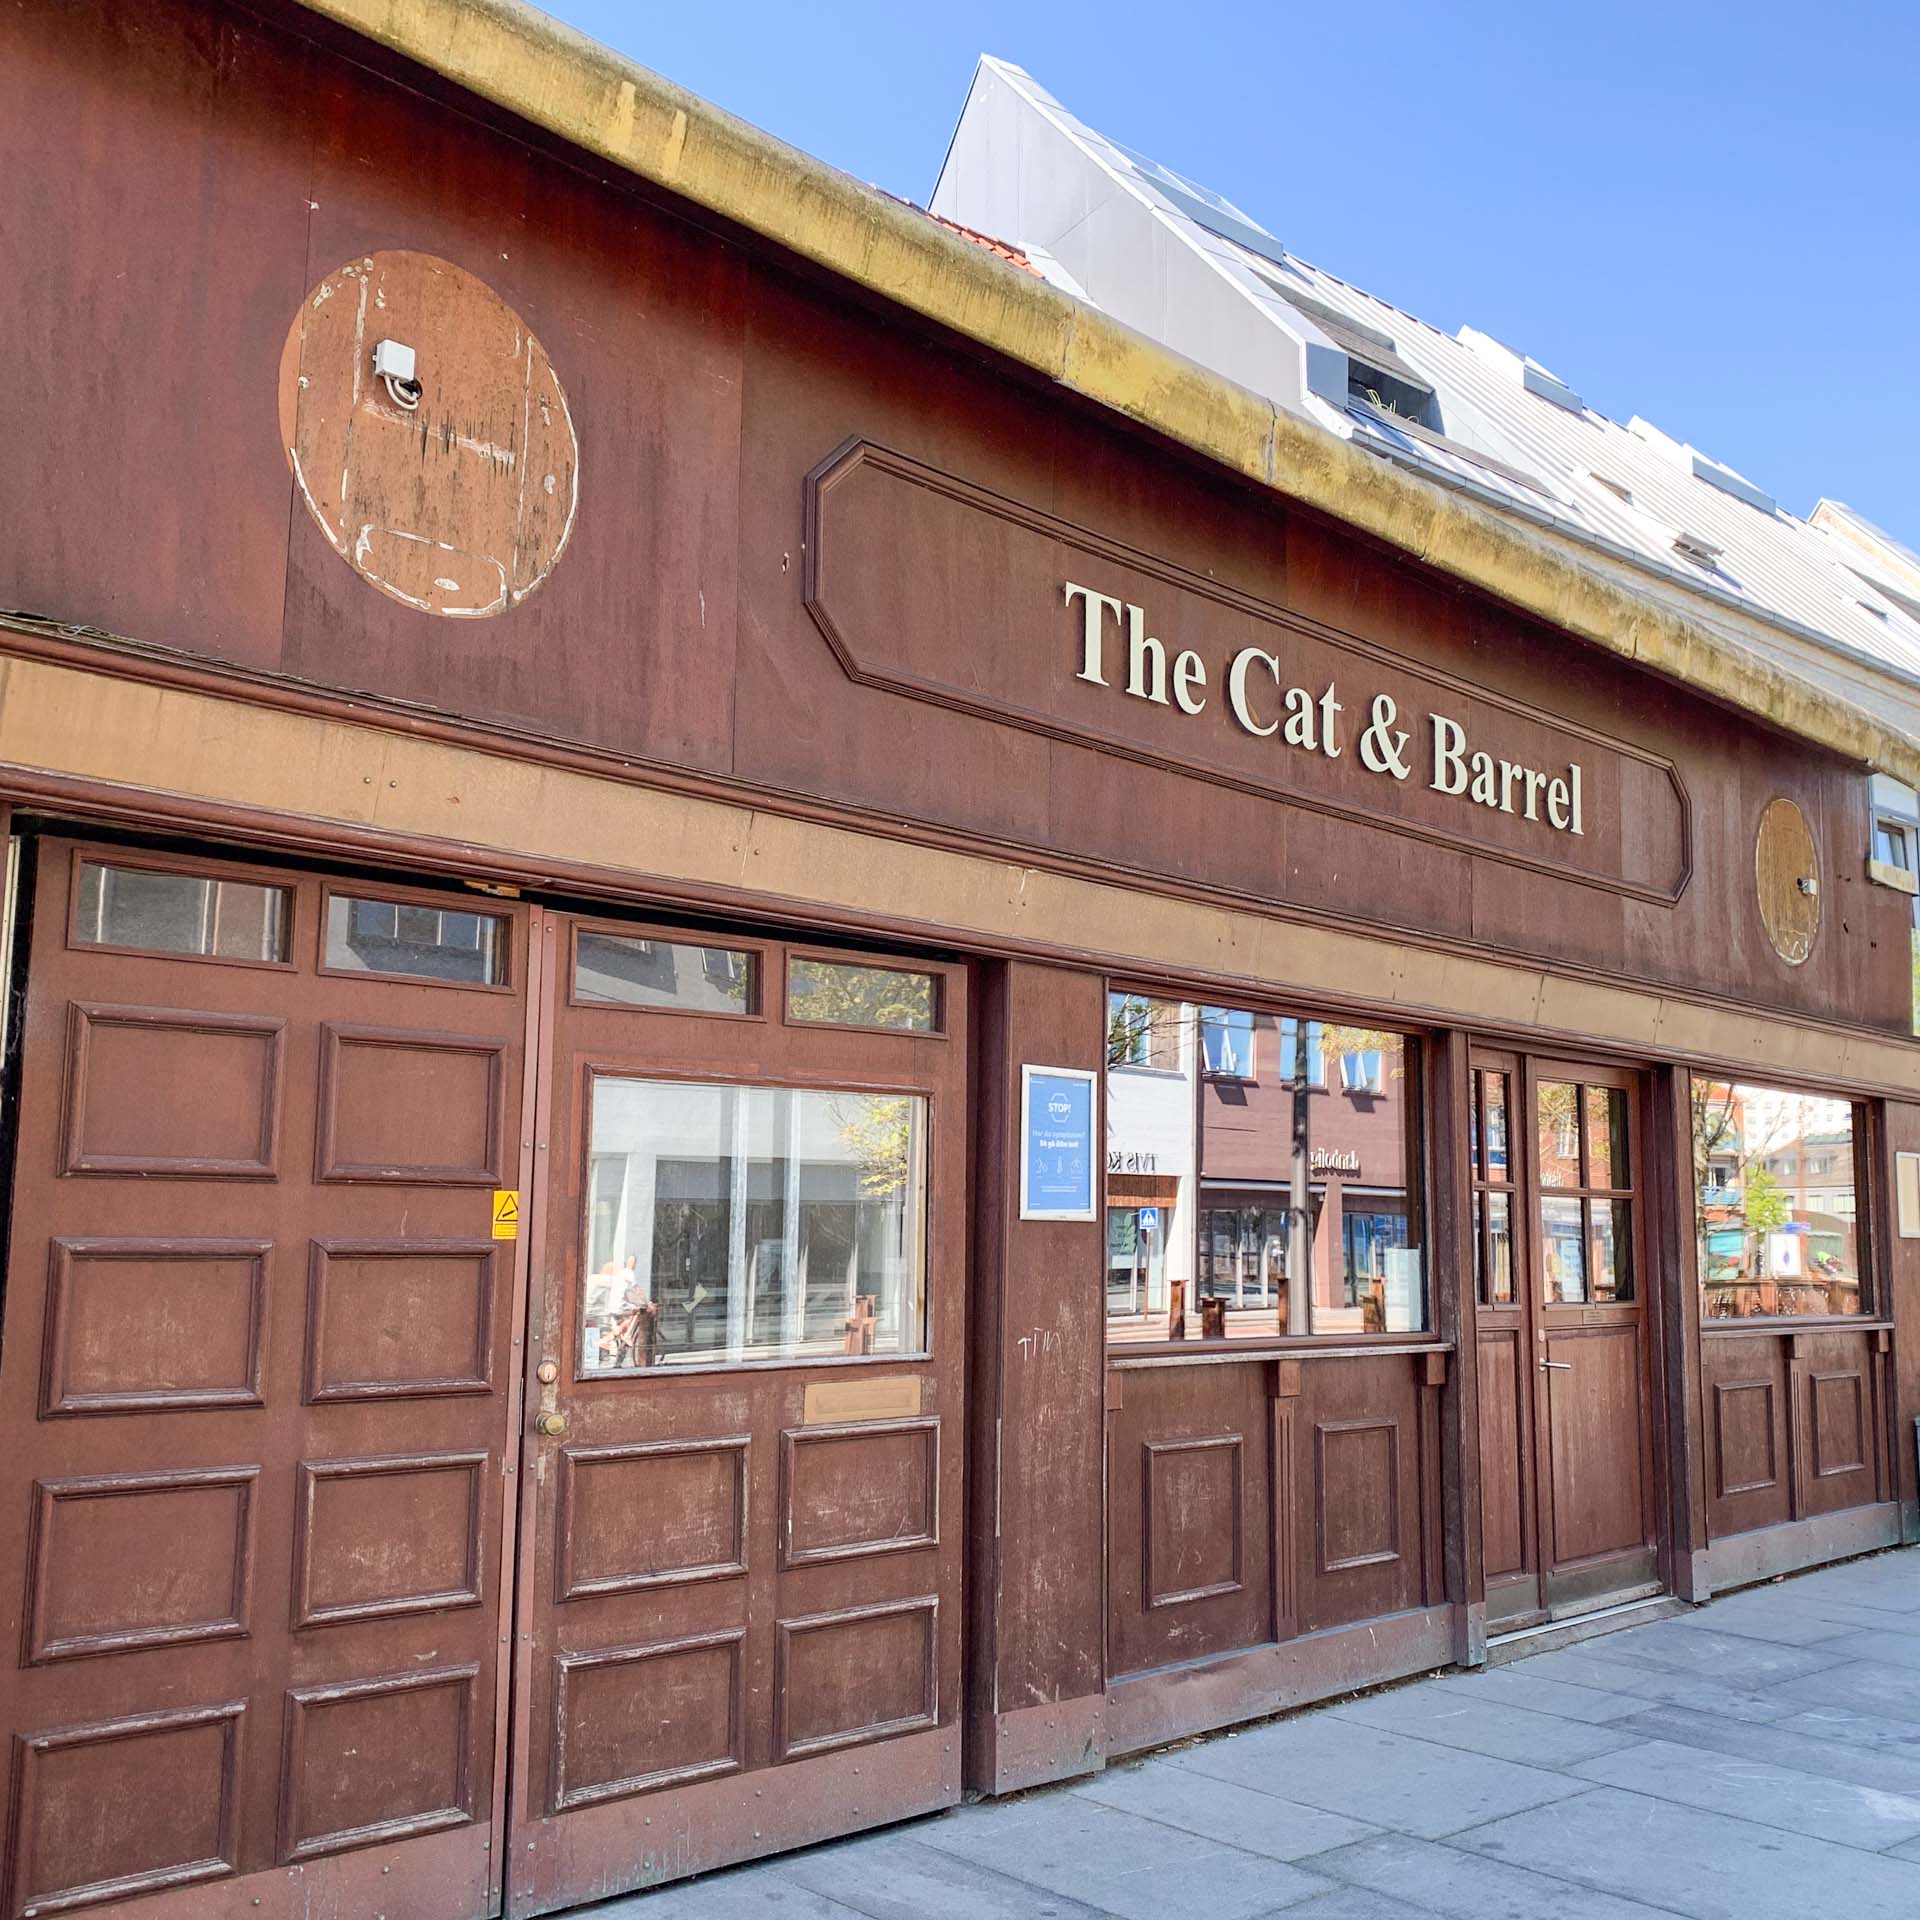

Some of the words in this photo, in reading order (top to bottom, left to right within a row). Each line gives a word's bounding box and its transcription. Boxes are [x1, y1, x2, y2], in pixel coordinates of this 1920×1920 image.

[1065, 582, 1208, 716] The
[1229, 647, 1343, 759] Cat
[1360, 694, 1412, 780] &
[1429, 712, 1585, 836] Barrel
[1048, 1103, 1071, 1113] STOP!
